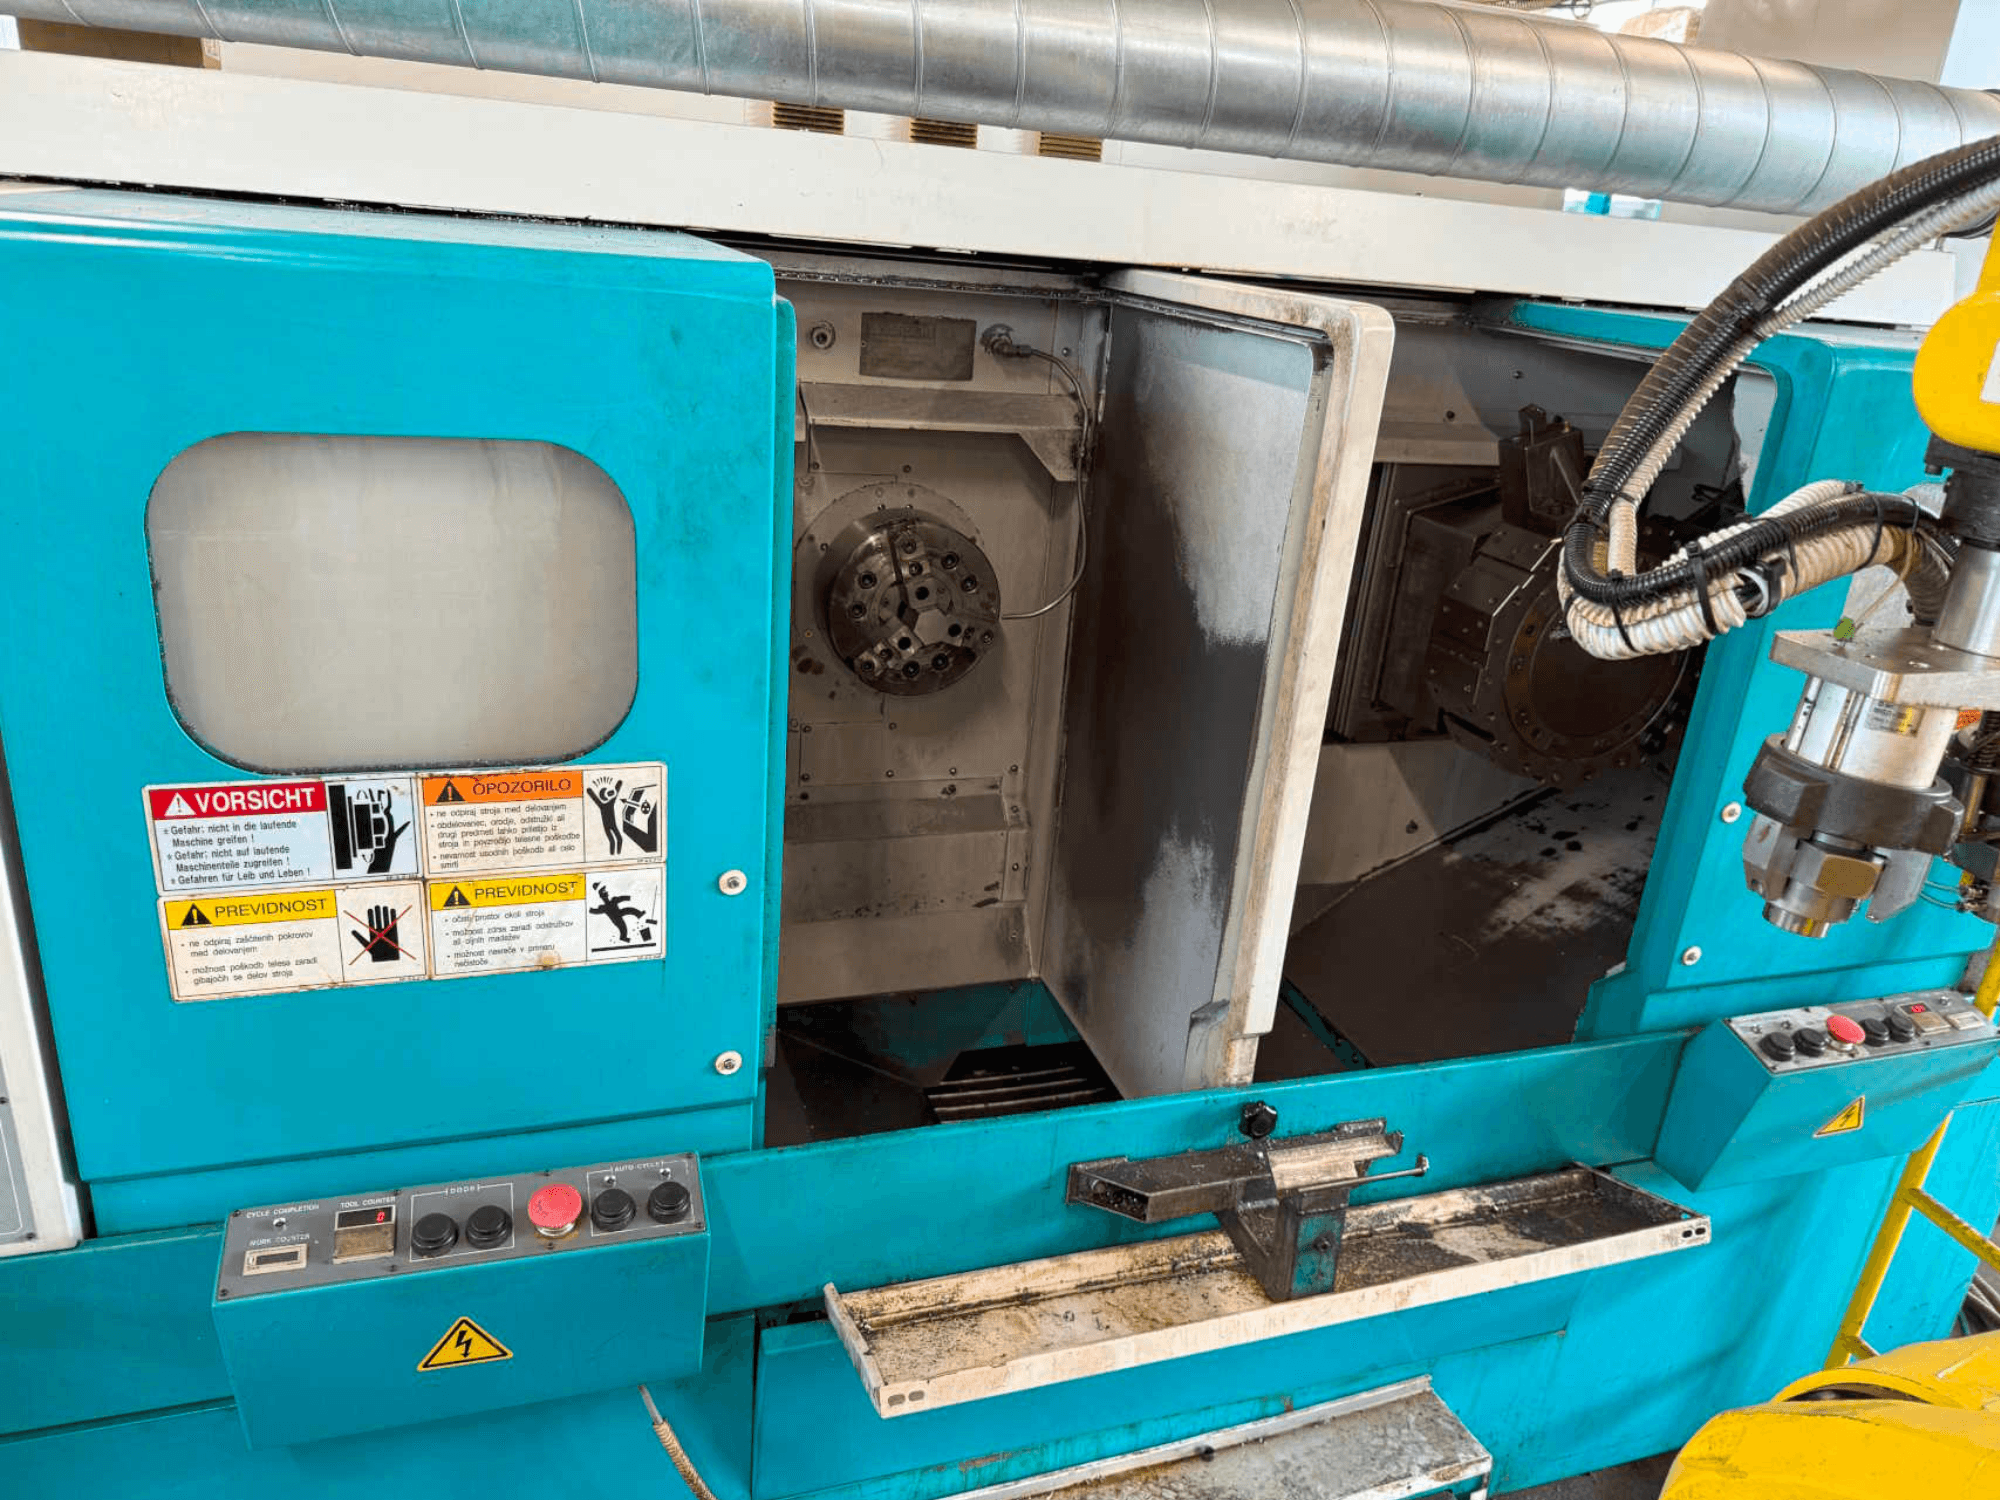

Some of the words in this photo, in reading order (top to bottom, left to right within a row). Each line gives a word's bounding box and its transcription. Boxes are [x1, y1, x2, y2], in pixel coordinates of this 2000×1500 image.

[473, 779, 571, 795] OPOZORILO
[194, 787, 315, 813] VORSICHT
[208, 823, 229, 833] nicht
[232, 822, 241, 831] in
[244, 820, 257, 830] die
[260, 820, 297, 830] laufende
[172, 836, 213, 848] Maschine
[217, 834, 248, 846] greifen
[211, 848, 232, 859] nicht
[236, 848, 249, 856] auf
[253, 845, 290, 855] laufende
[176, 860, 240, 872] Maschinenteile
[244, 859, 282, 870] zugreifen
[178, 874, 219, 884] Gefahren
[222, 872, 233, 882] für
[237, 872, 255, 880] Leib
[259, 870, 274, 879] und
[278, 868, 303, 878] Leben
[475, 881, 578, 899] PREVIDNOST
[215, 898, 327, 918] PREVIDNOST
[278, 931, 313, 941] pokrovov
[191, 949, 209, 957] med
[230, 961, 264, 973] poškodb
[615, 1164, 634, 1172] AUTO
[340, 1201, 360, 1209] TOOL
[362, 1196, 396, 1206] COUNTER
[246, 1211, 269, 1219] CYCLE
[274, 1204, 320, 1215] COMPLETION
